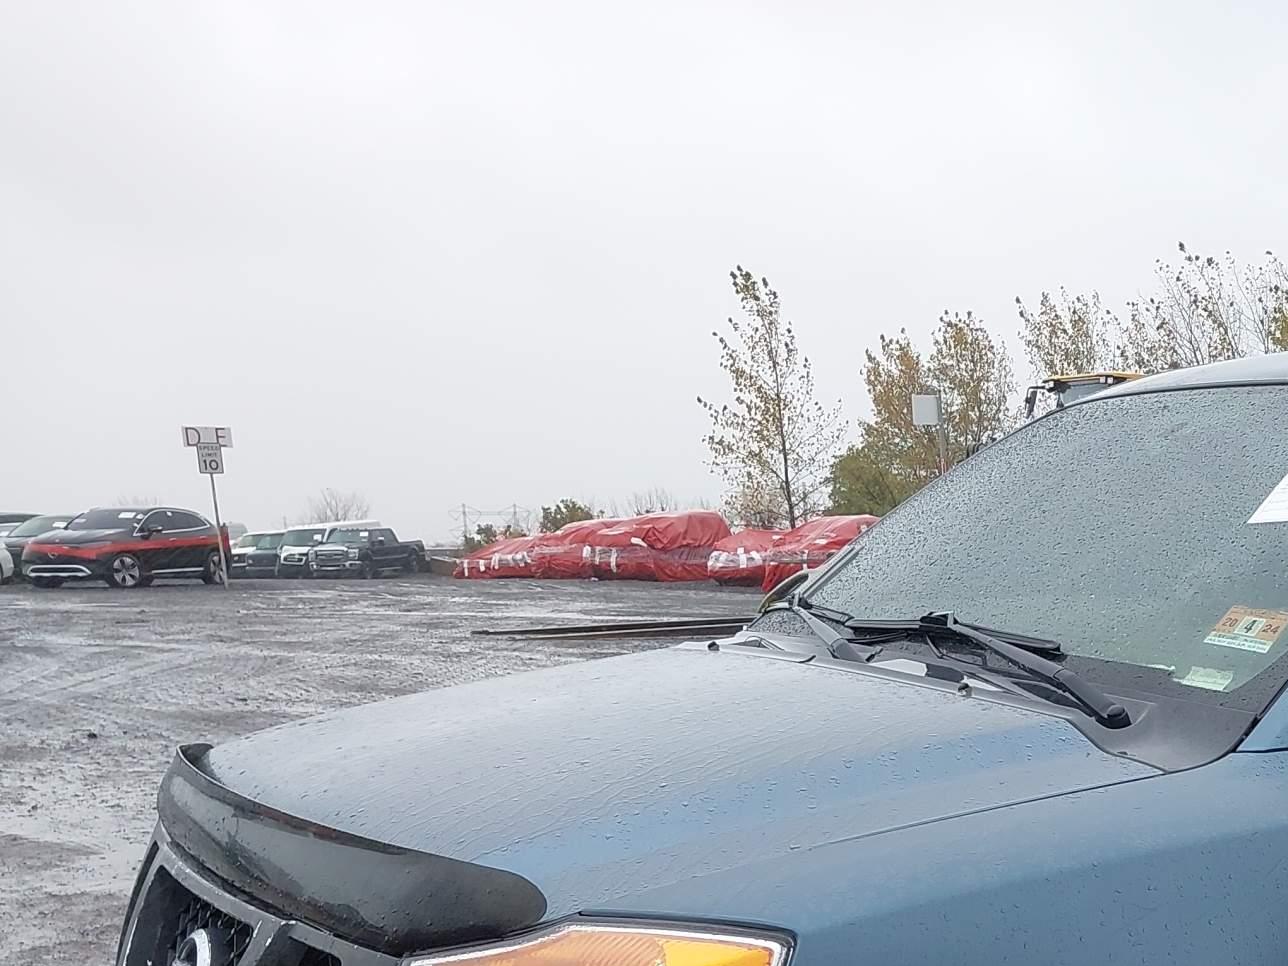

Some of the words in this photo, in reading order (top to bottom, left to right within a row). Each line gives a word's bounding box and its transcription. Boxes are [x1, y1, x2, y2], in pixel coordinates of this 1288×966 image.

[185, 427, 201, 446] D
[203, 459, 219, 471] 10
[1221, 617, 1239, 628] 20
[1243, 619, 1258, 634] 4
[1261, 623, 1281, 635] 24
